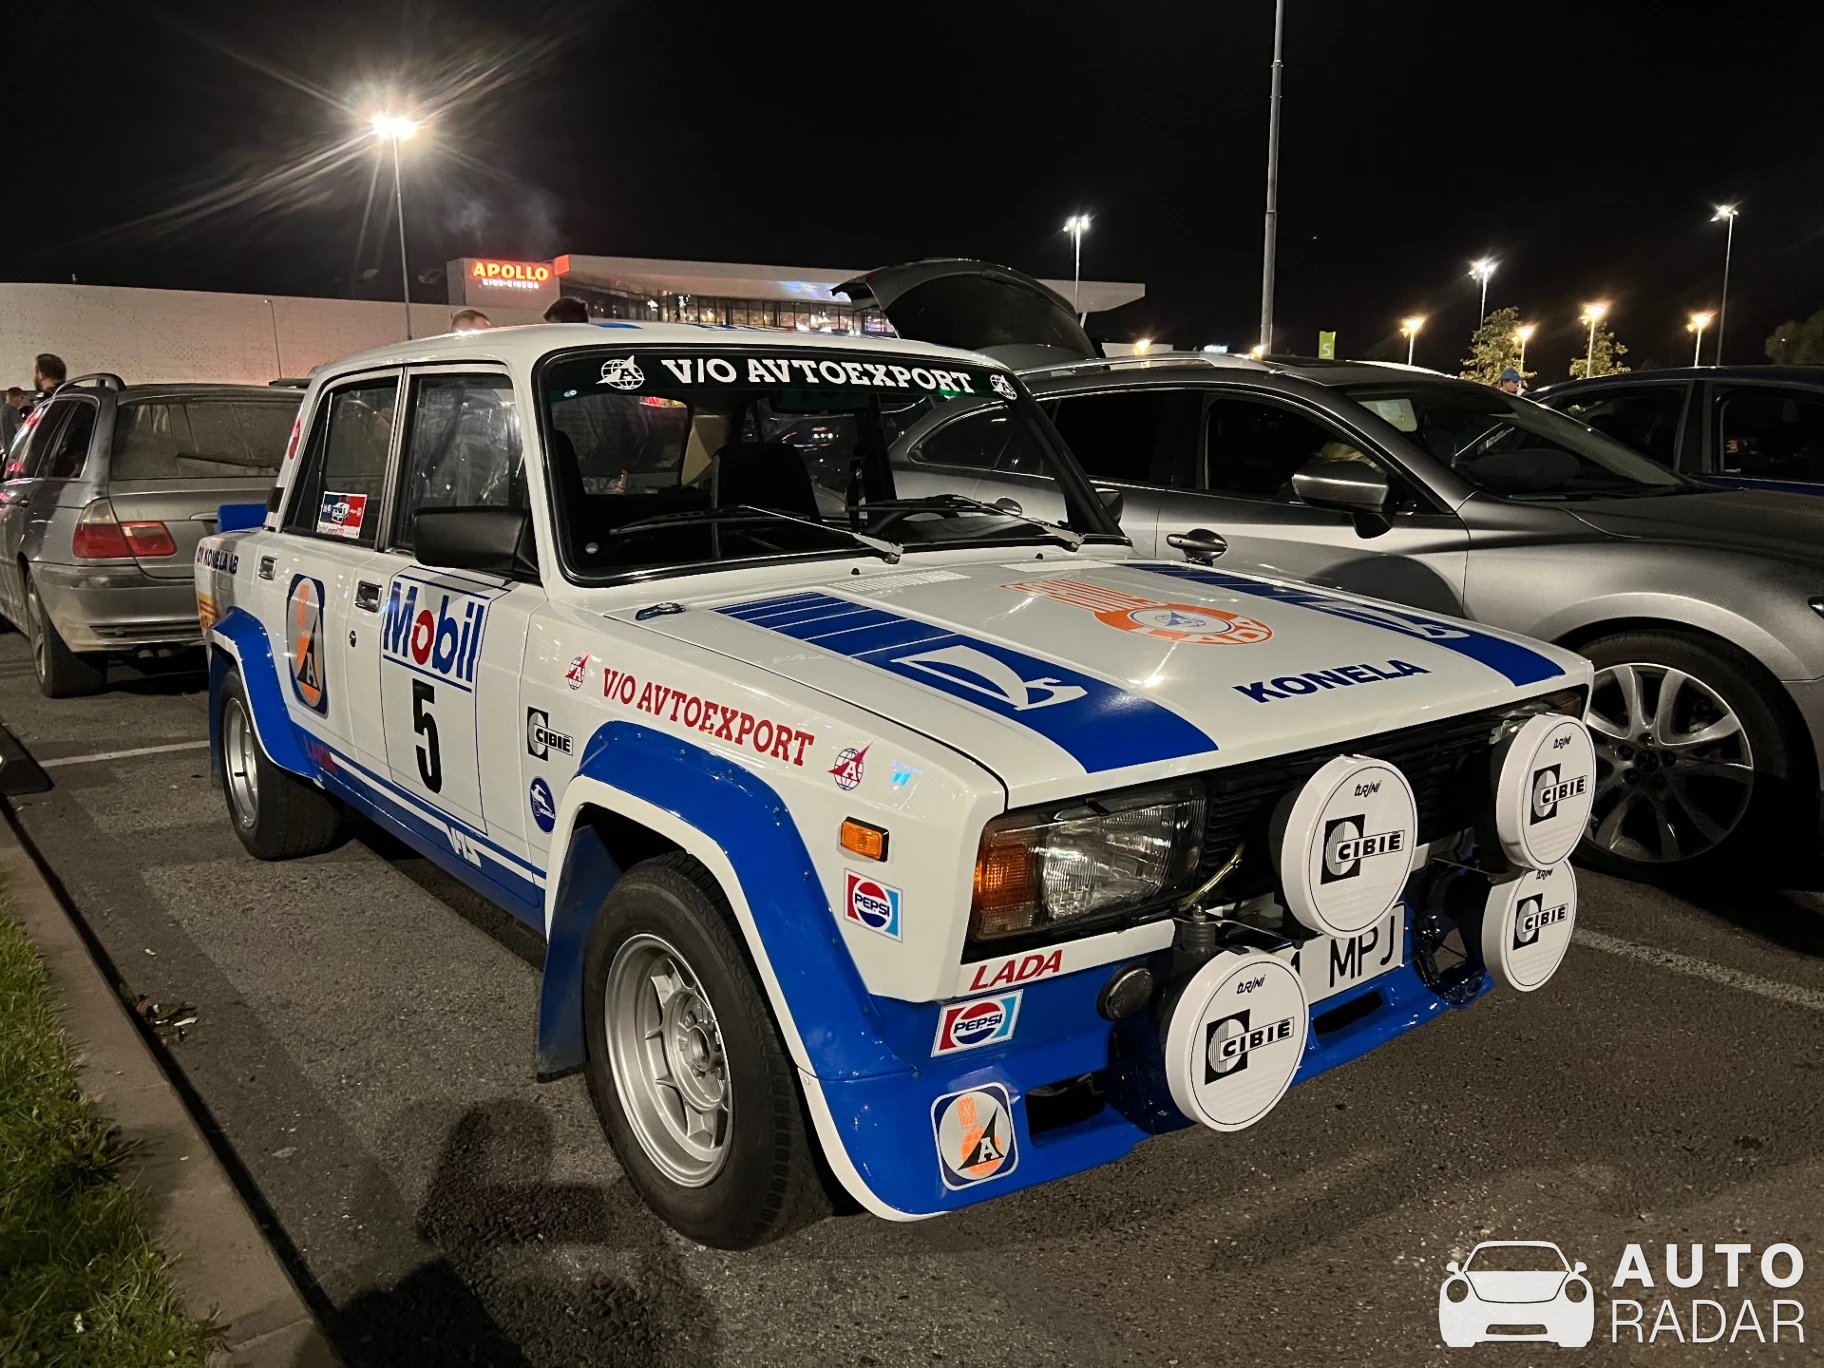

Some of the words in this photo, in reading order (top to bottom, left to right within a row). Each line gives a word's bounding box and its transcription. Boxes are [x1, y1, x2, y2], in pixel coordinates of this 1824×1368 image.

[473, 262, 549, 281] APOLLO
[1322, 343, 1331, 357] 5
[661, 358, 737, 384] V/O
[747, 358, 972, 394] AVTOEXPORT
[383, 581, 486, 683] Mobil
[1232, 659, 1433, 703] KONELA
[412, 678, 443, 794] 5
[603, 667, 636, 705] V/O
[636, 681, 815, 767] AVTOEXPORT
[854, 892, 890, 918] PEPSI
[969, 949, 1063, 992] LADA
[953, 1013, 1003, 1034] PEPSI
